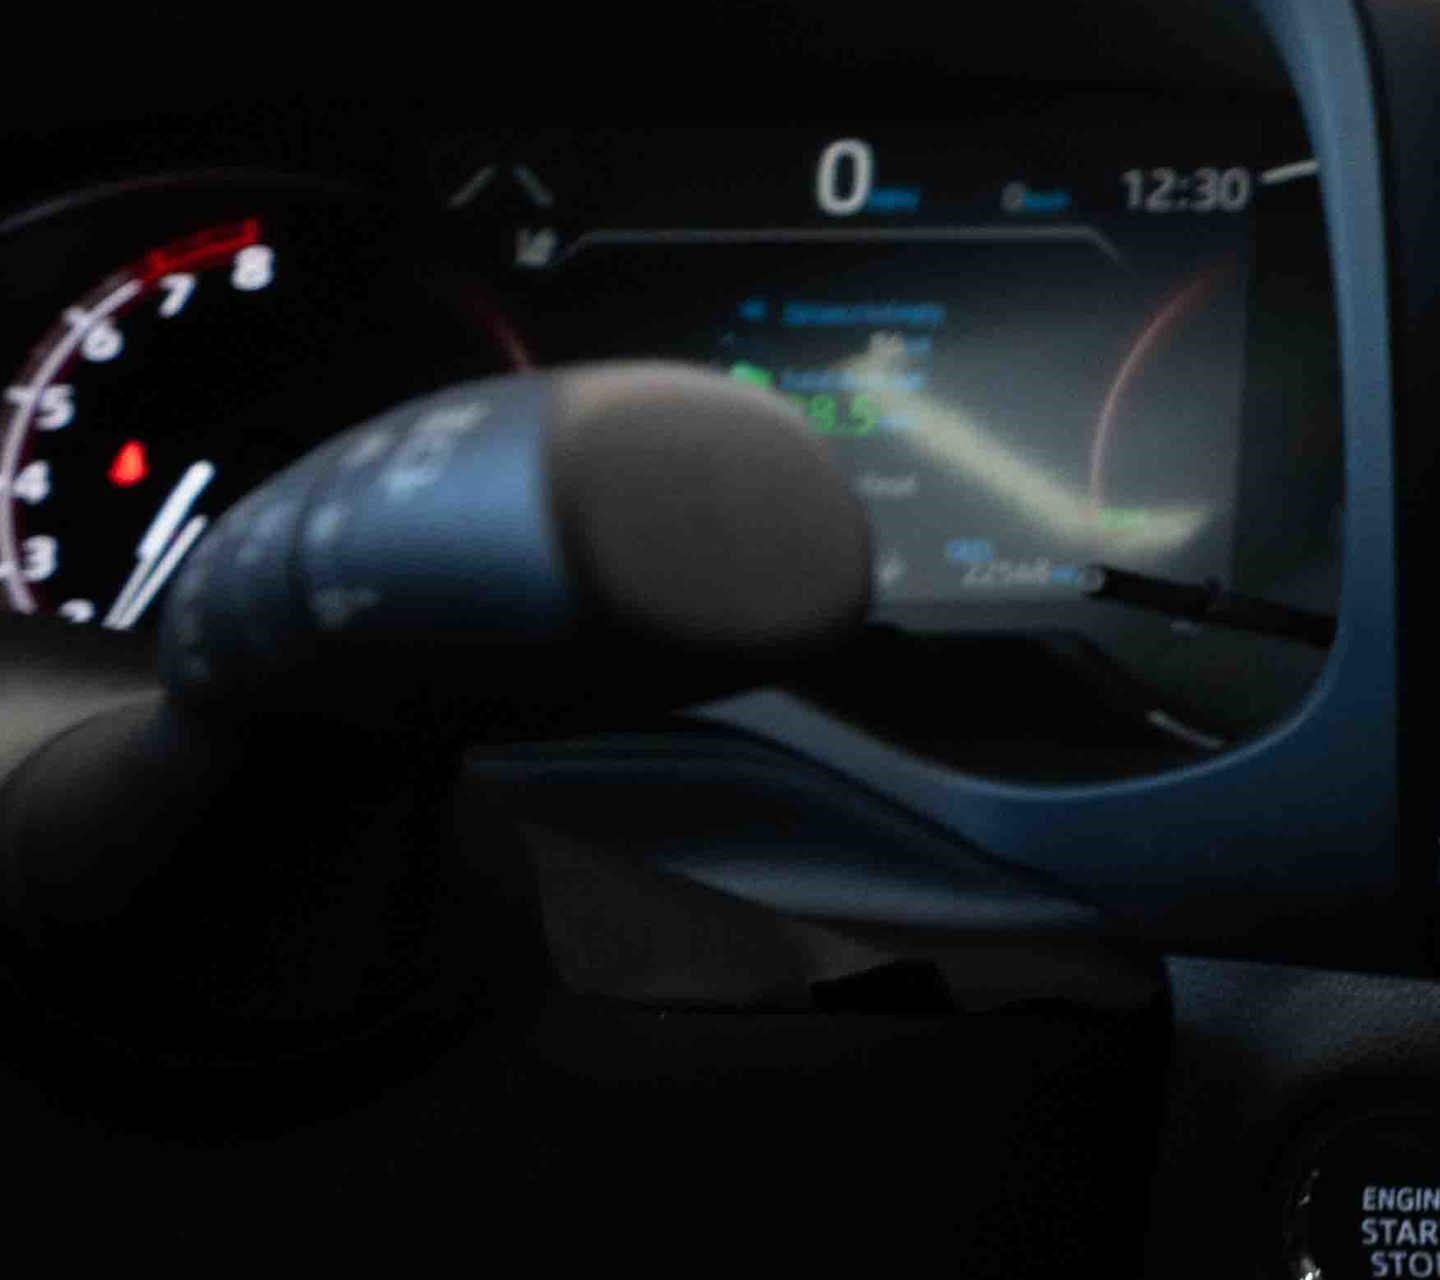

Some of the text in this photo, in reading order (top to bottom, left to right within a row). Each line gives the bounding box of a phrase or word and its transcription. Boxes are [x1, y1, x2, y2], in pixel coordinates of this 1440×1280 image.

[816, 139, 874, 217] 0
[1121, 167, 1251, 214] 12:30
[231, 244, 276, 292] 8
[157, 273, 196, 318] 7
[82, 318, 124, 363] 6
[39, 384, 76, 431] 5
[14, 461, 52, 505] 4
[26, 536, 58, 582] 3
